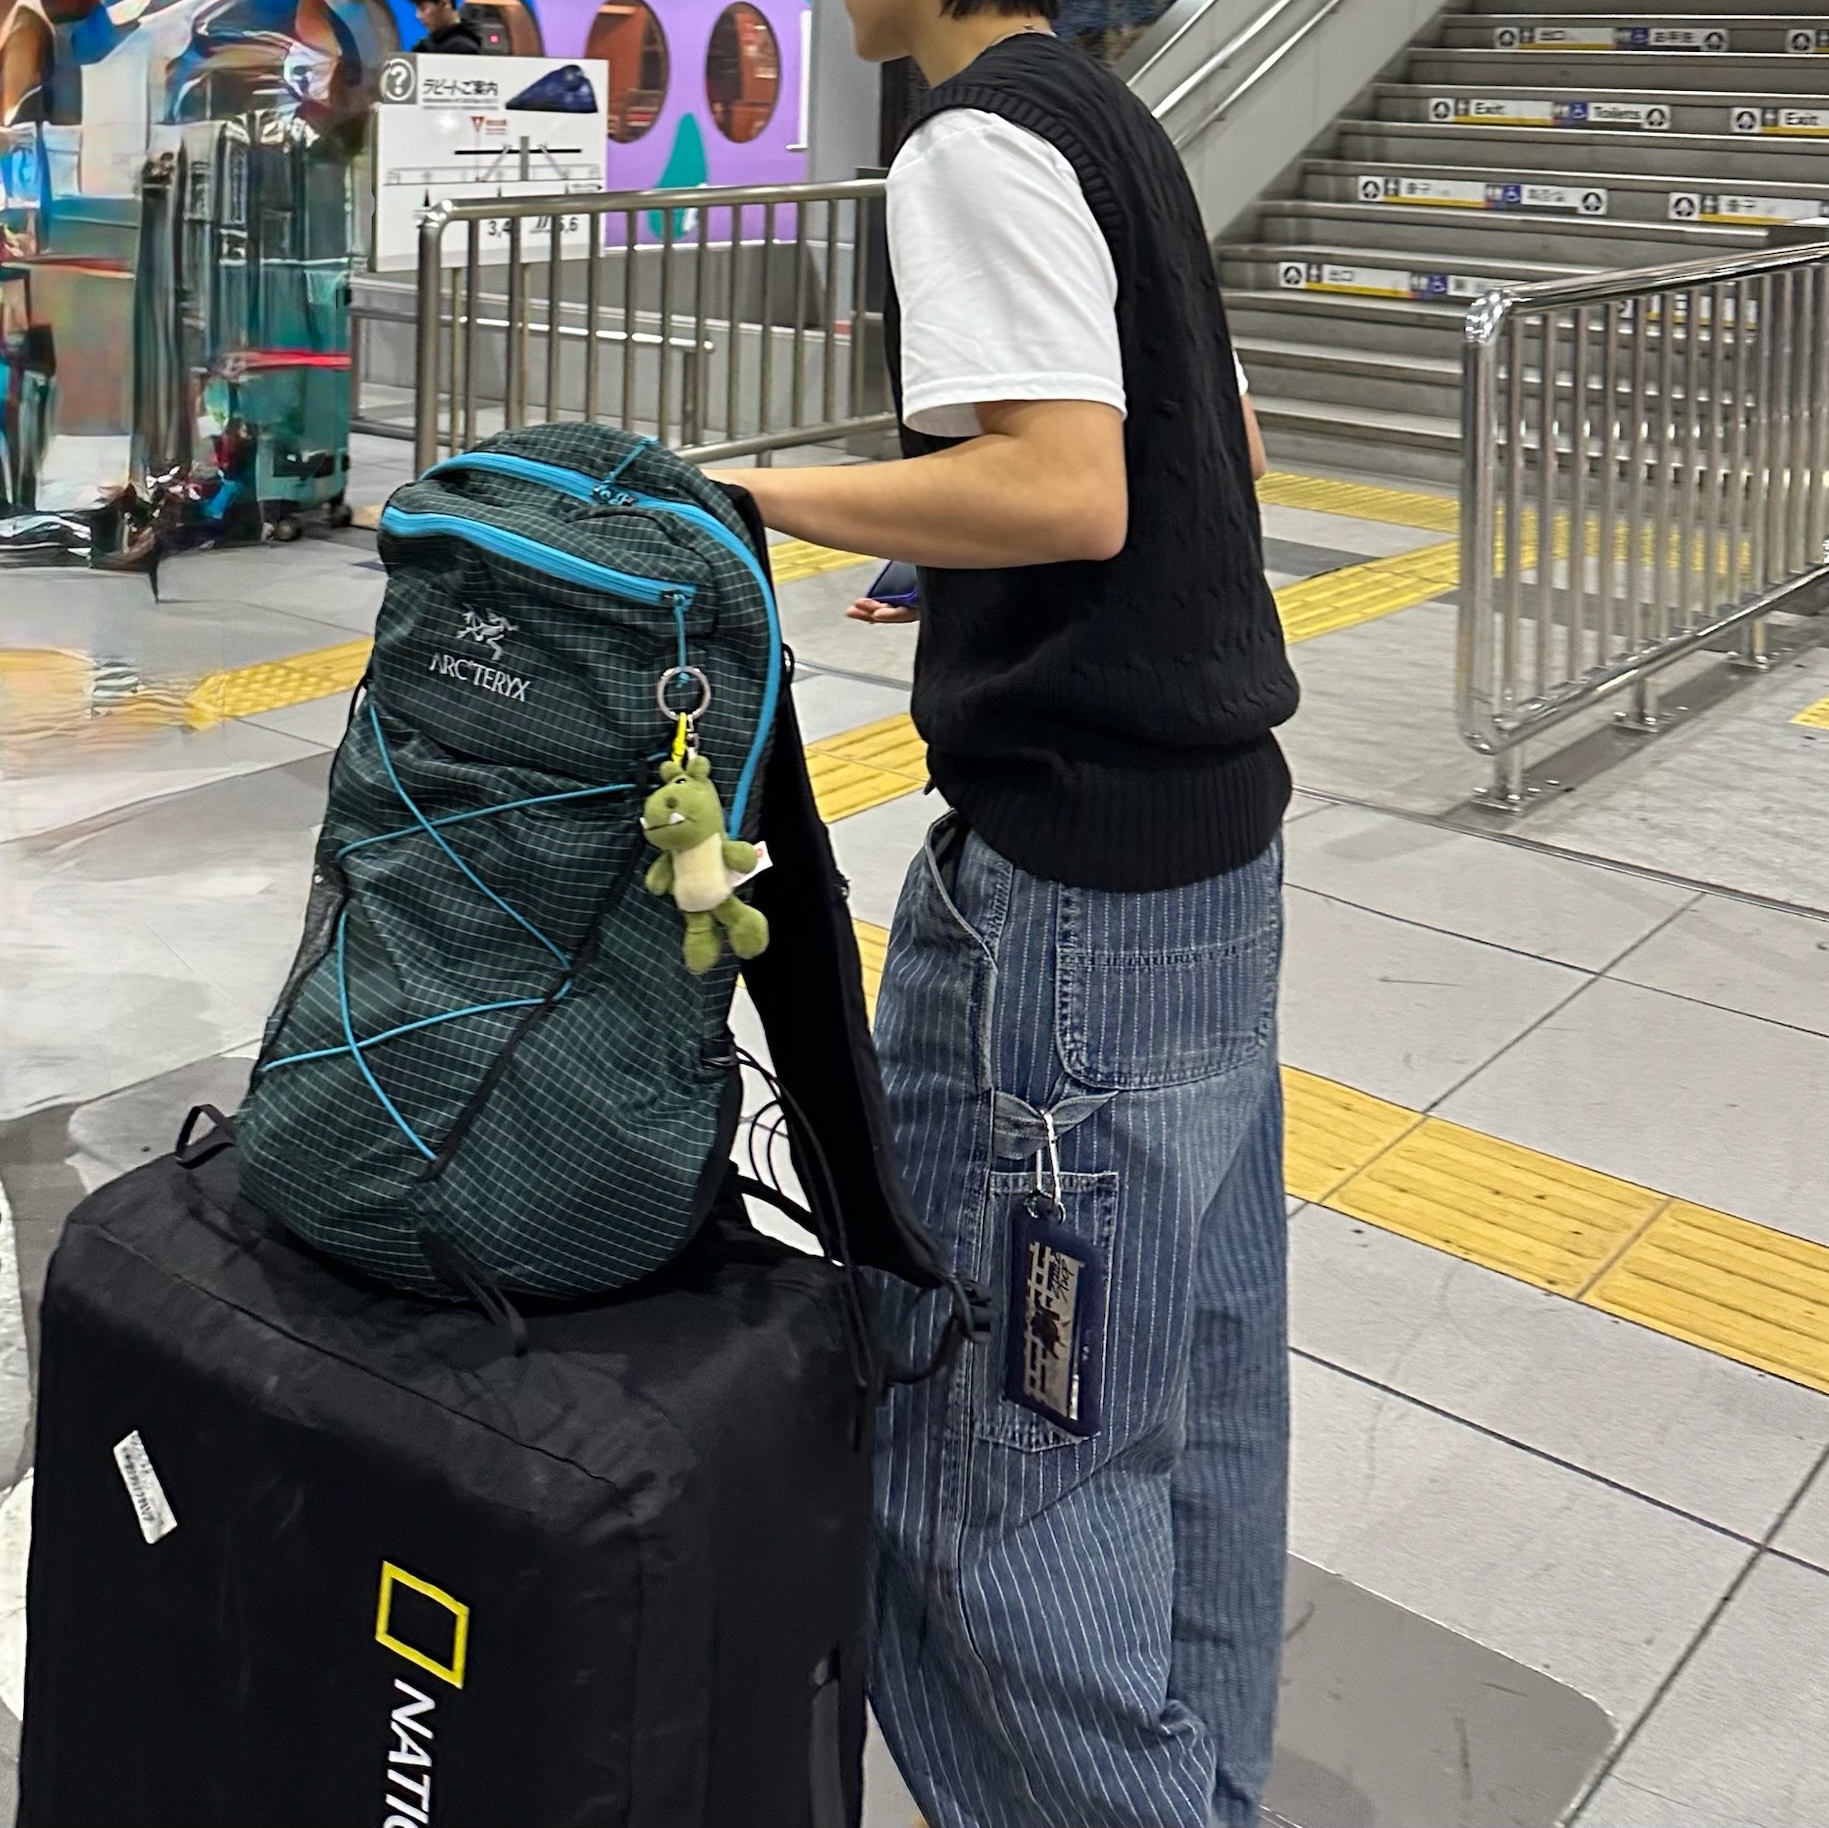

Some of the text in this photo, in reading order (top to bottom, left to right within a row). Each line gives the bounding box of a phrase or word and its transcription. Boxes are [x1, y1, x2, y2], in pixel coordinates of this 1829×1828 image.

[1475, 102, 1504, 115] Exit
[1785, 111, 1819, 125] Exit
[382, 1678, 436, 1828] NATI
